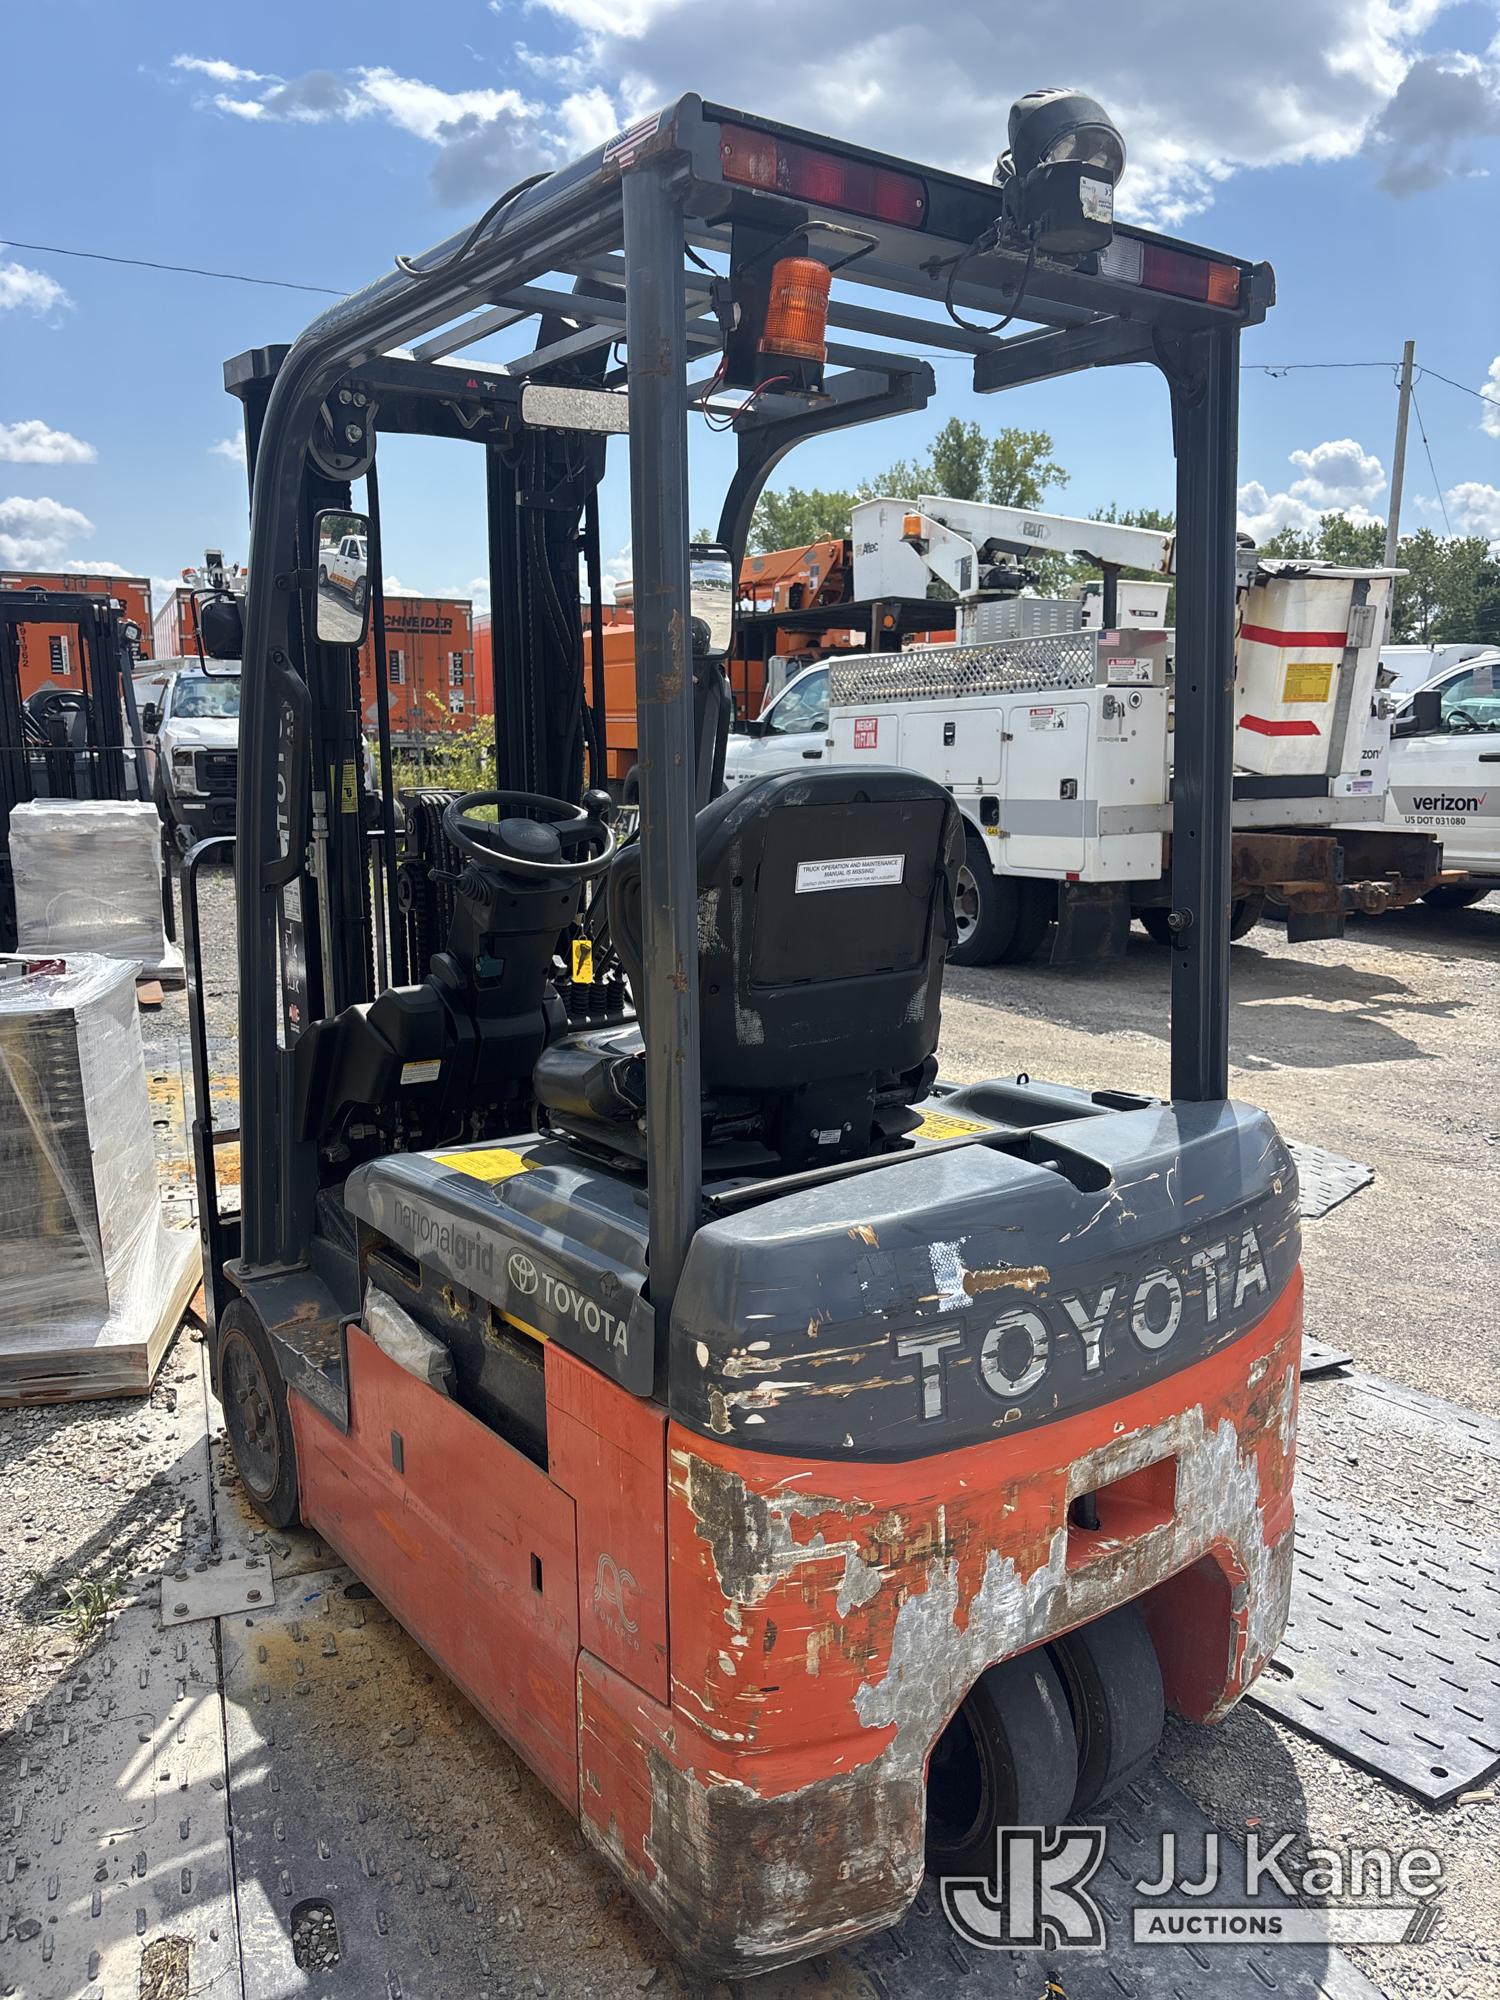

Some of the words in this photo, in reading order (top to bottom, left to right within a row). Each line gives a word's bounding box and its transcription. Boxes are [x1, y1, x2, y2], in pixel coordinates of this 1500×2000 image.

[383, 615, 454, 629] CHNEIDER
[1412, 793, 1478, 811] verizon
[1405, 815, 1415, 824] US
[1416, 816, 1433, 825] DOT
[1435, 816, 1466, 825] 031080
[820, 863, 850, 872] OPERATION
[861, 860, 898, 868] MAINTENANCE
[824, 870, 846, 878] MANUAL
[541, 1271, 628, 1356] TOYOTA
[896, 1224, 1270, 1420] TOYOTA
